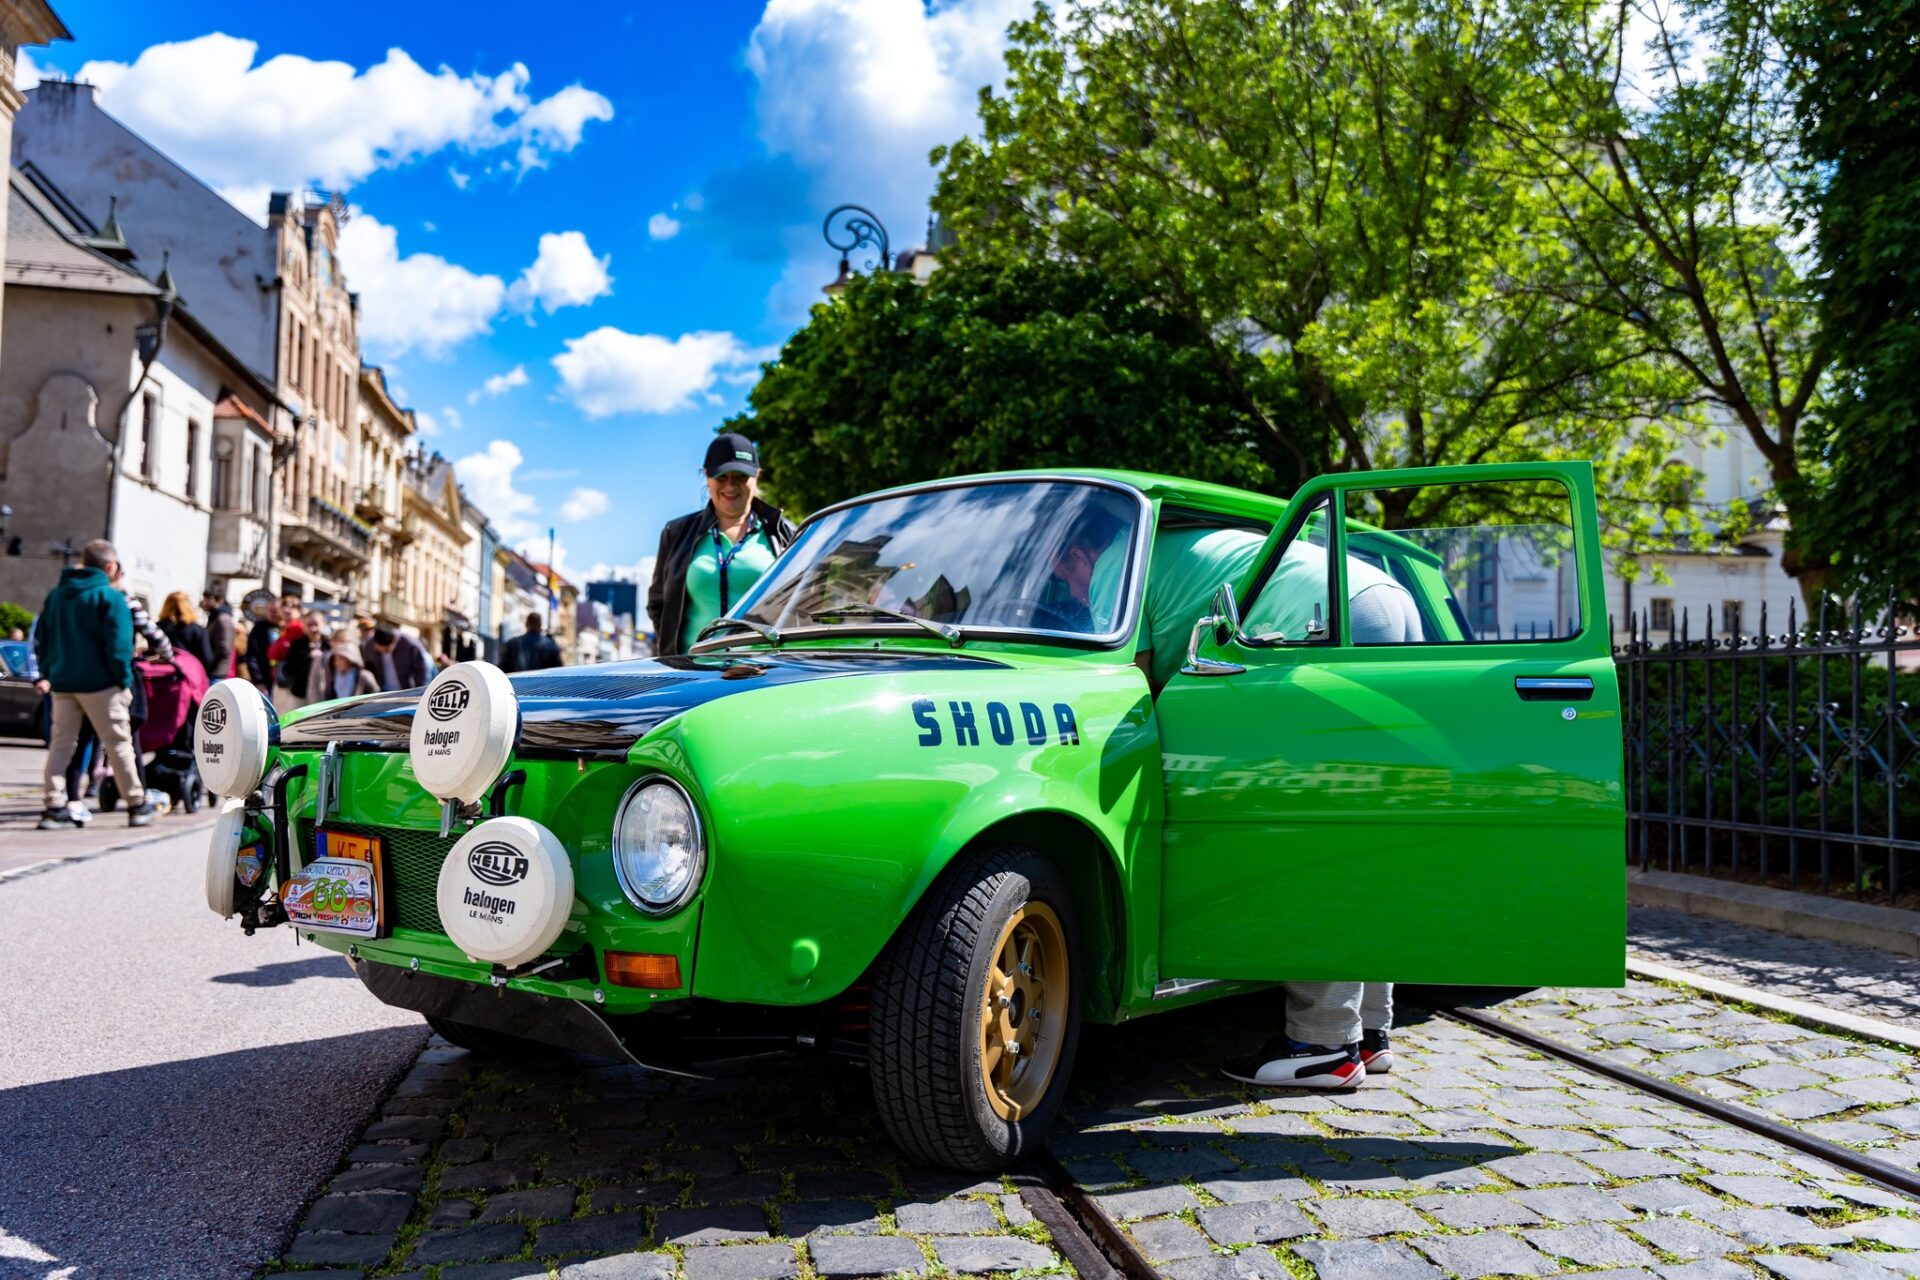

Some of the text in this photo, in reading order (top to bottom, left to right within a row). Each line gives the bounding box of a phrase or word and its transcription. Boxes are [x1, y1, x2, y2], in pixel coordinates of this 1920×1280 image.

[430, 689, 470, 709] HELLA
[202, 708, 227, 726] HELLA
[202, 739, 224, 757] halogen
[424, 728, 460, 748] halogen
[434, 748, 452, 756] MANS
[471, 854, 529, 880] HELLA
[313, 877, 347, 912] 66
[463, 886, 516, 915] halogen
[469, 910, 504, 924] LE MANS
